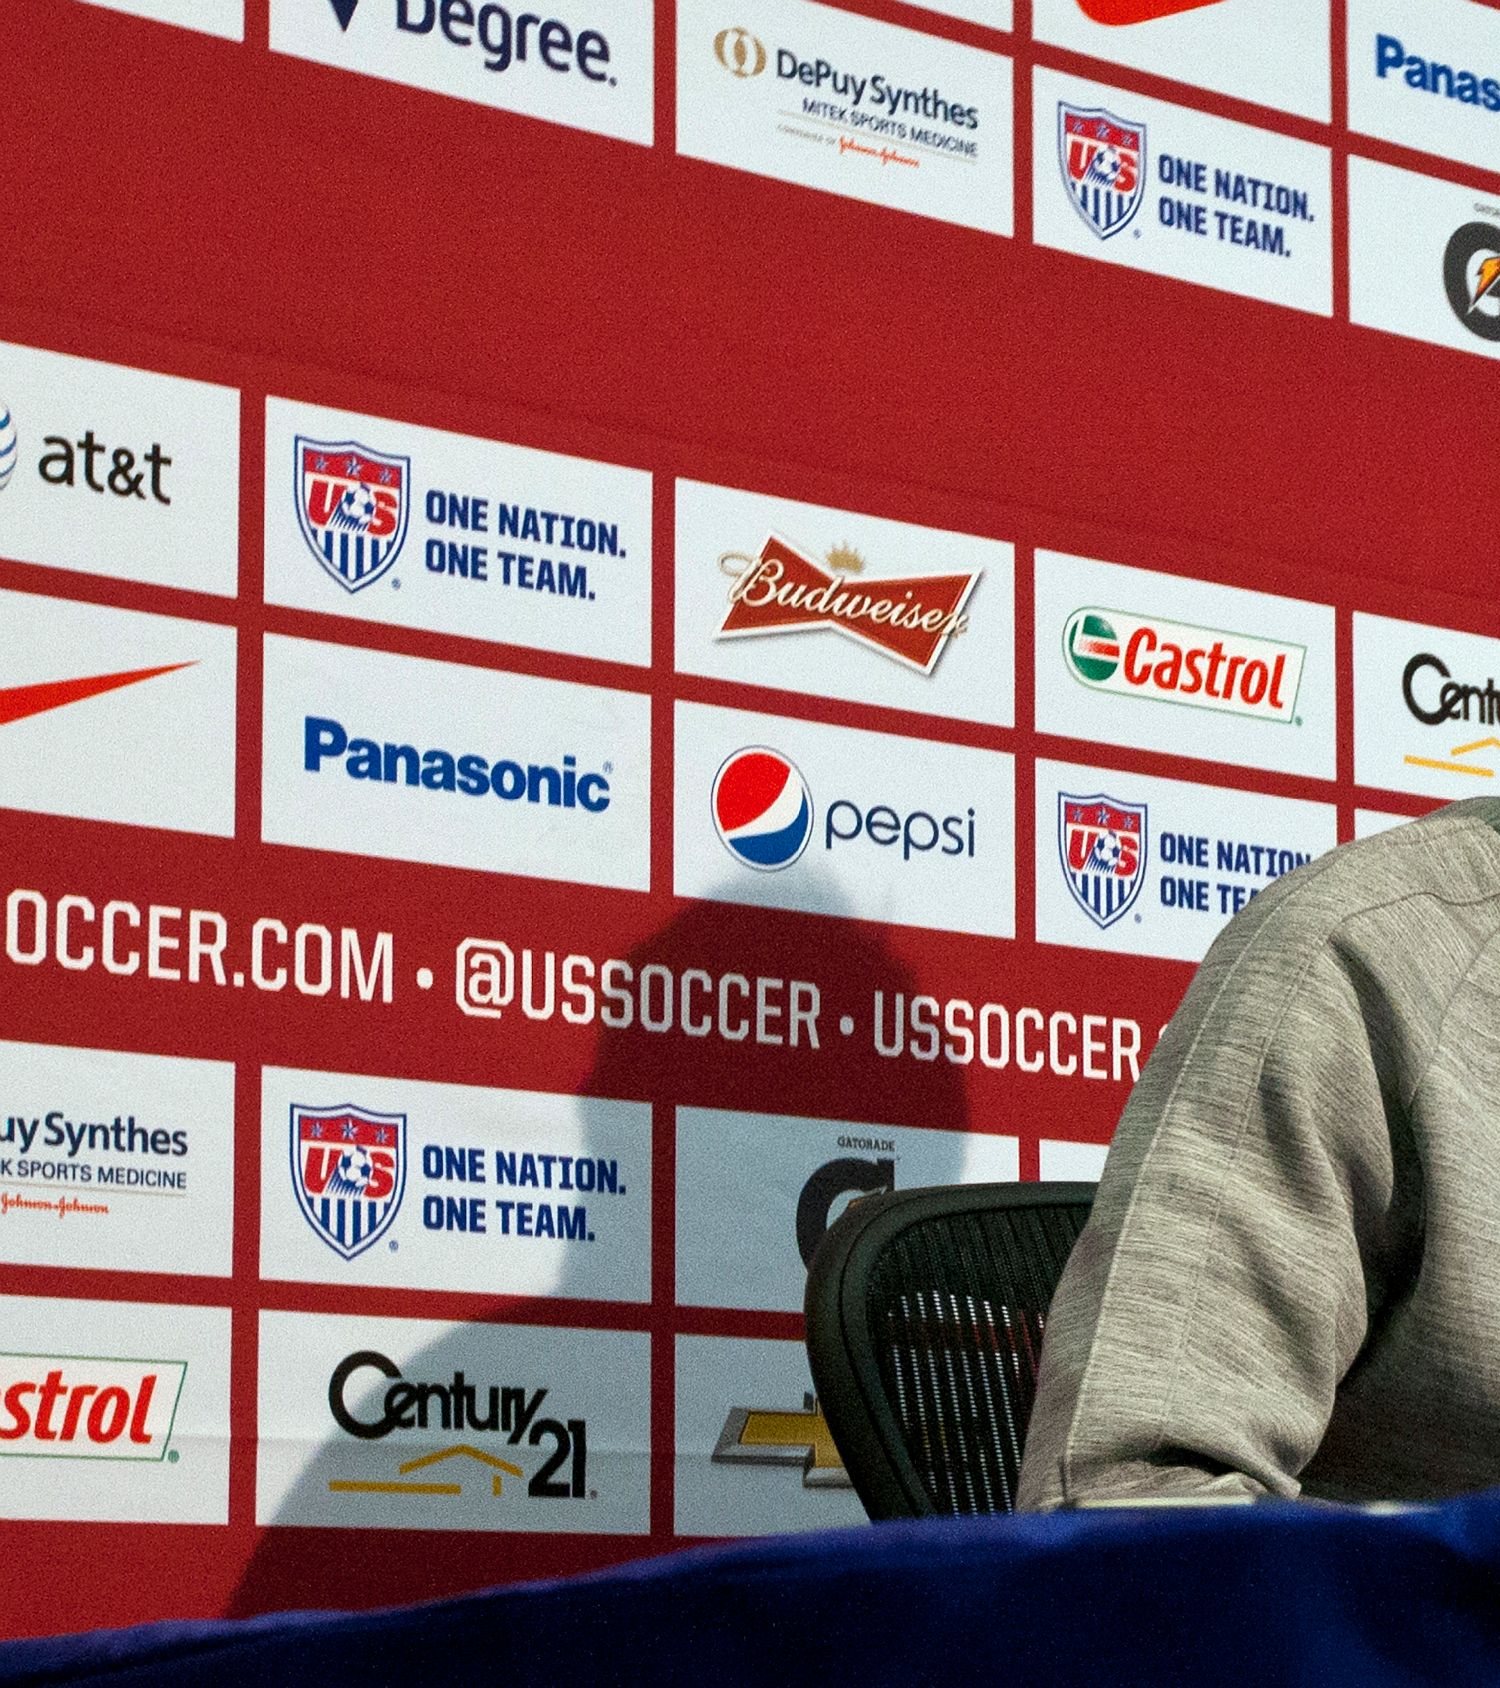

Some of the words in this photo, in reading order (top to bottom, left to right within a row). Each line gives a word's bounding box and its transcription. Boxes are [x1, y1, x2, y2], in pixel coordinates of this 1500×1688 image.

[776, 49, 867, 105] DePuy
[871, 74, 979, 130] Synthes
[802, 97, 847, 124] MITEK
[850, 110, 906, 139] SPORTS
[910, 126, 979, 158] MEDICINE
[1157, 153, 1207, 195] ONE
[1214, 161, 1315, 223] NATION.
[1157, 196, 1207, 238] ONE
[1214, 208, 1292, 258] TEAM.
[38, 429, 173, 506] at&t
[425, 490, 488, 533] ONE
[499, 503, 627, 559] NATION.
[425, 538, 488, 582] ONE
[498, 548, 597, 601] TEAM.
[717, 549, 970, 639] Budweiser
[1123, 626, 1287, 710] Castrol
[304, 715, 611, 813] Panasonic
[825, 797, 976, 861] pepsi
[1160, 831, 1209, 868] ONE
[1160, 876, 1209, 912] ONE
[456, 936, 821, 1050] @USSOCCER
[873, 989, 1168, 1084] USSOCCER
[44, 1111, 189, 1157] Synthes
[836, 1135, 896, 1153] GATORADE
[17, 1159, 92, 1182] SPORTS
[97, 1166, 187, 1190] MEDICINE
[422, 1145, 486, 1183] ONE
[496, 1149, 627, 1196] NATION.
[422, 1195, 486, 1233] ONE
[496, 1200, 597, 1242] TEAM.
[329, 1350, 549, 1444] Century
[528, 1418, 587, 1499] 21
